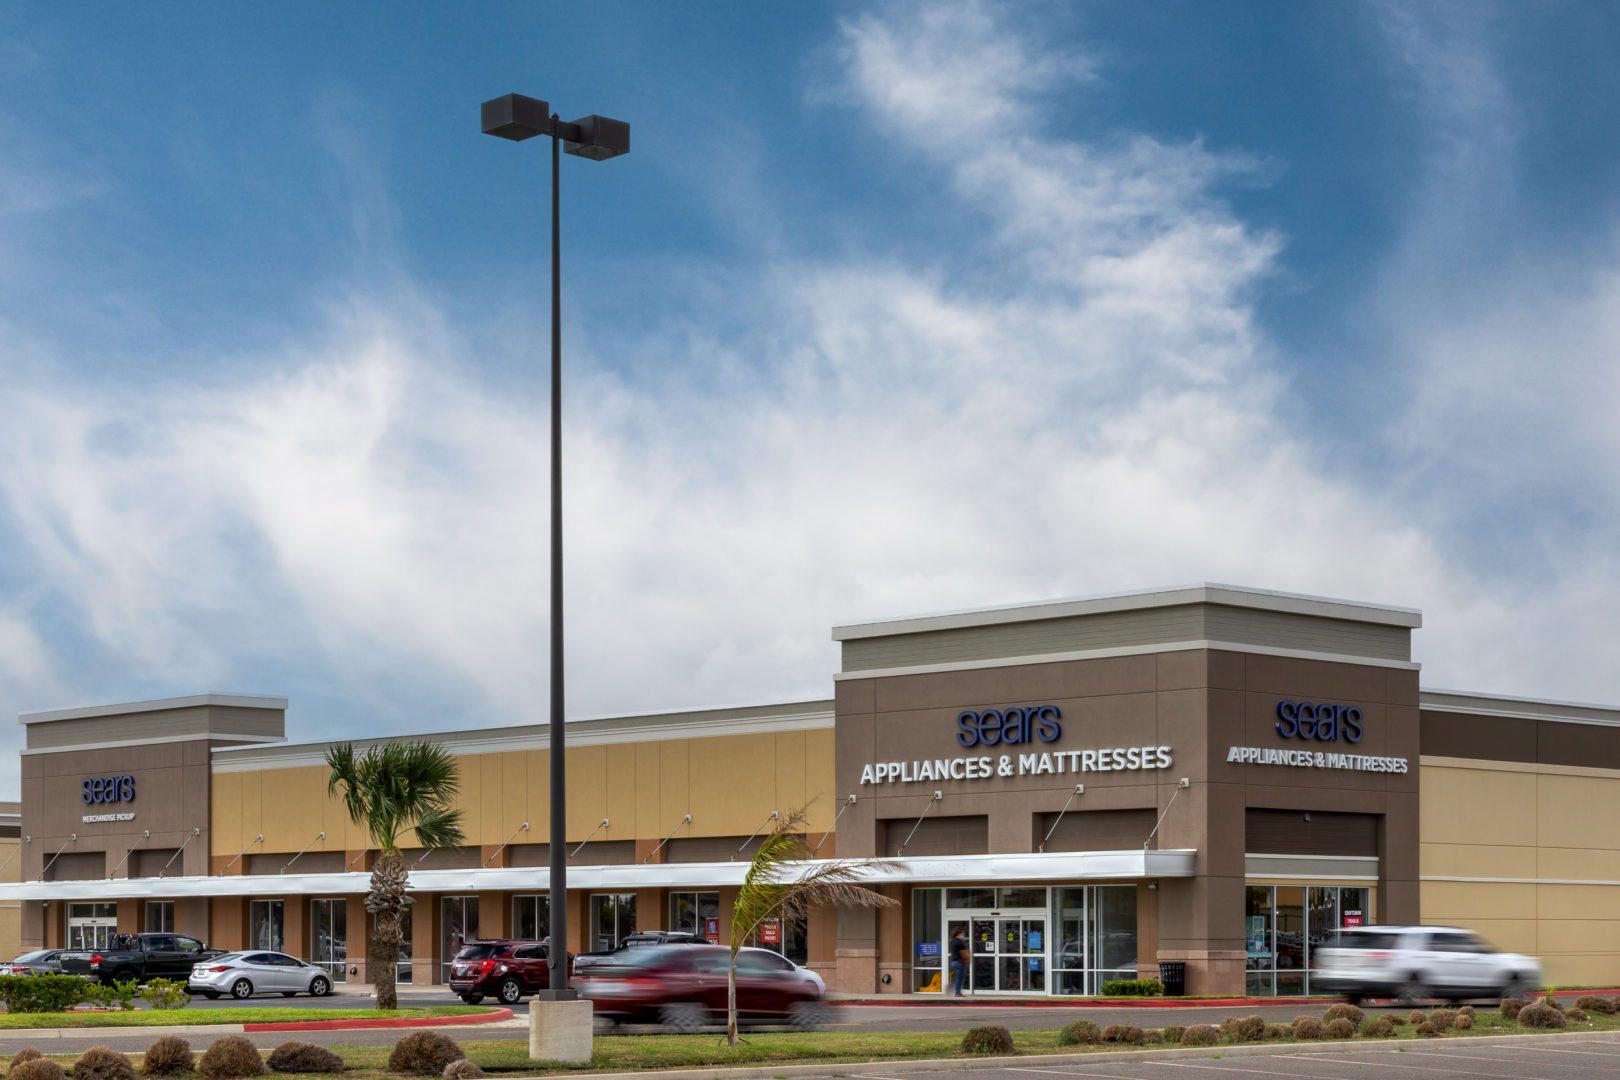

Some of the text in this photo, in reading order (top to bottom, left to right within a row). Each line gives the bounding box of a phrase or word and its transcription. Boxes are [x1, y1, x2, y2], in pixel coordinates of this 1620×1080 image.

[956, 704, 1062, 747] sears
[1276, 699, 1363, 743] sears
[860, 746, 1173, 785] APPLIANCES & MATTRESSES
[1226, 746, 1408, 774] APPLIANCES & MATTRESSES
[82, 776, 136, 805] sears
